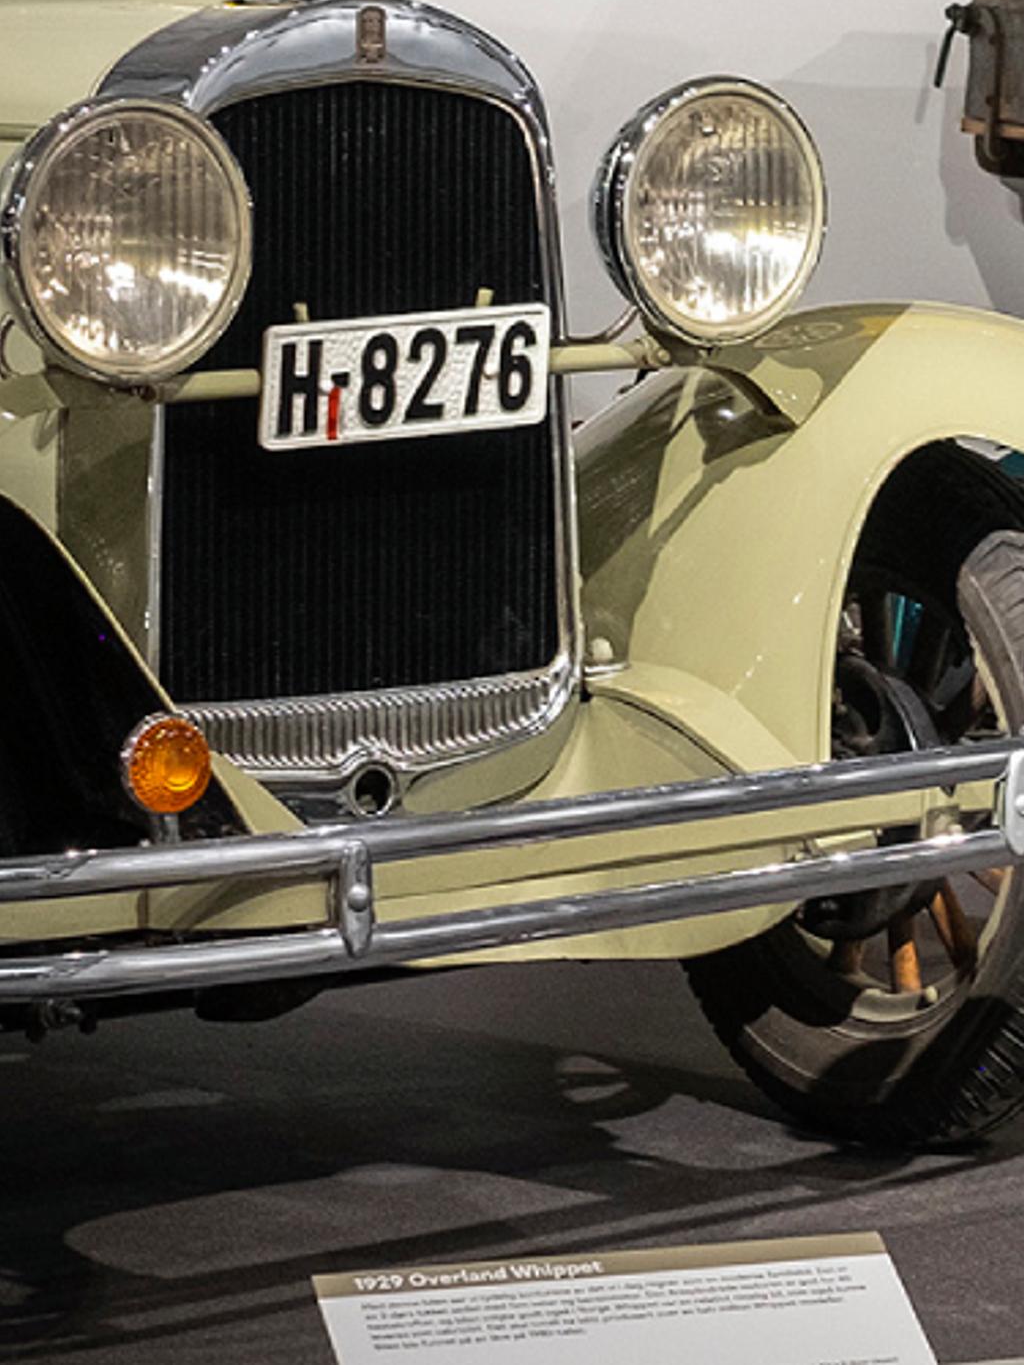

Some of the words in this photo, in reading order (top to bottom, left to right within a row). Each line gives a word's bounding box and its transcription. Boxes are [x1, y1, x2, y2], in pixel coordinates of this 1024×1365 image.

[274, 320, 537, 439] H-8276
[354, 1274, 403, 1291] 1929
[409, 1266, 507, 1288] Overland
[510, 1259, 604, 1280] Whippet
